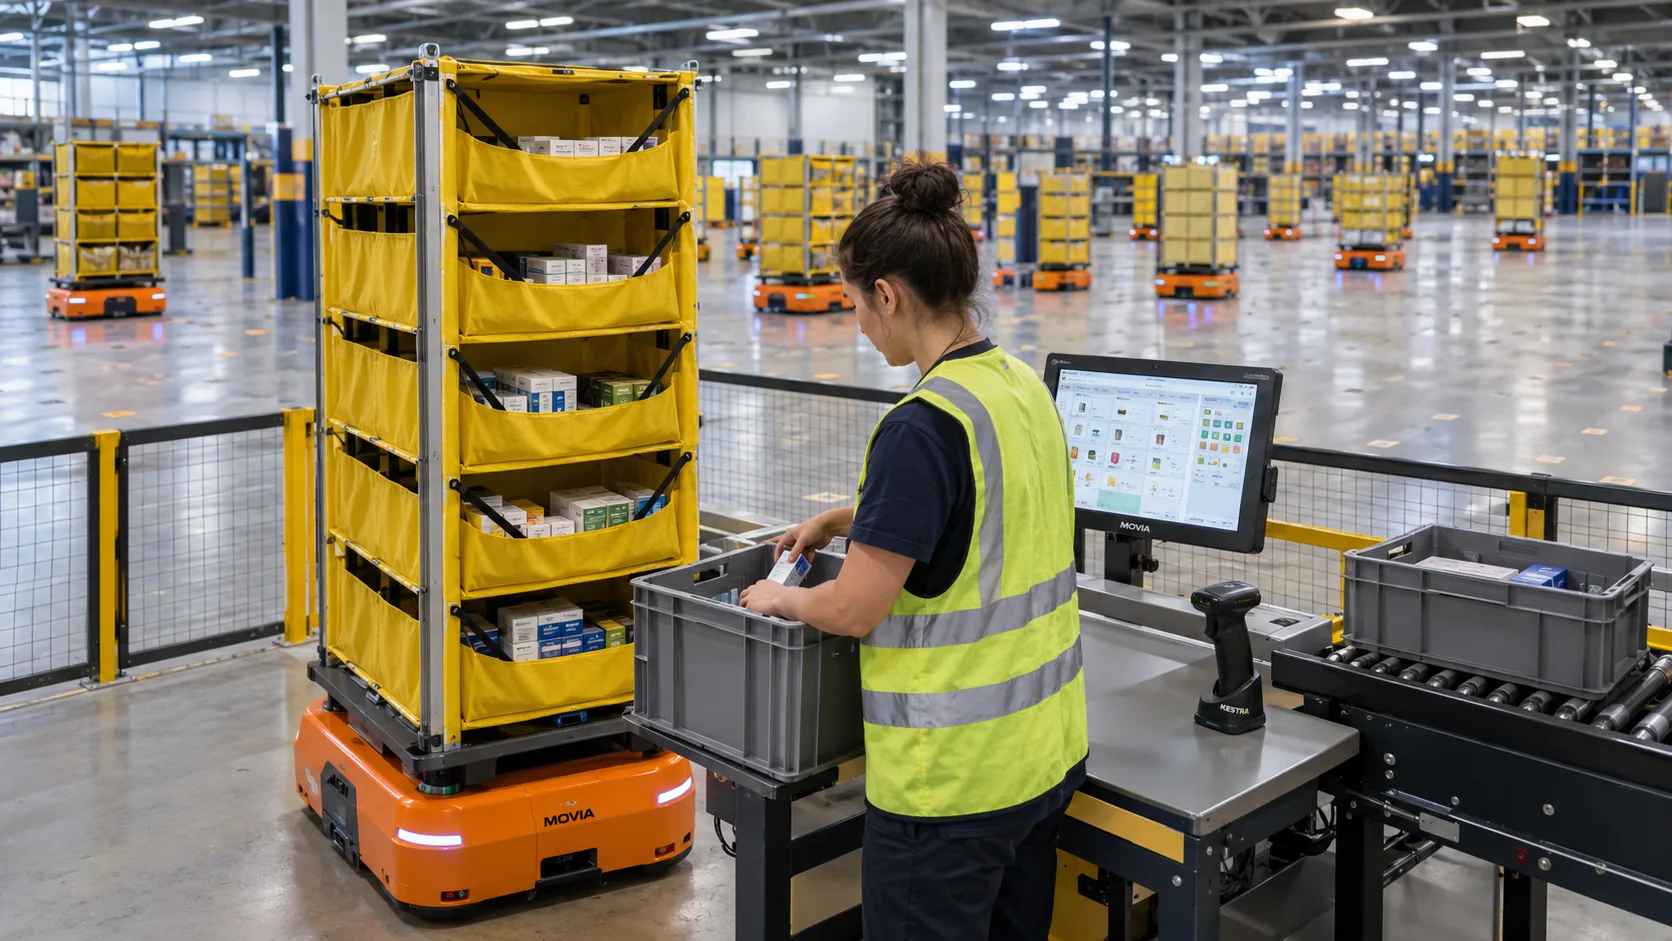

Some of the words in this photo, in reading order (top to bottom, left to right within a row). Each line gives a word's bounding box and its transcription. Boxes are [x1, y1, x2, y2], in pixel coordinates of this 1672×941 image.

[1120, 521, 1150, 533] MOVIA
[1220, 703, 1249, 715] KESTRA
[544, 808, 595, 827] MOVIA
